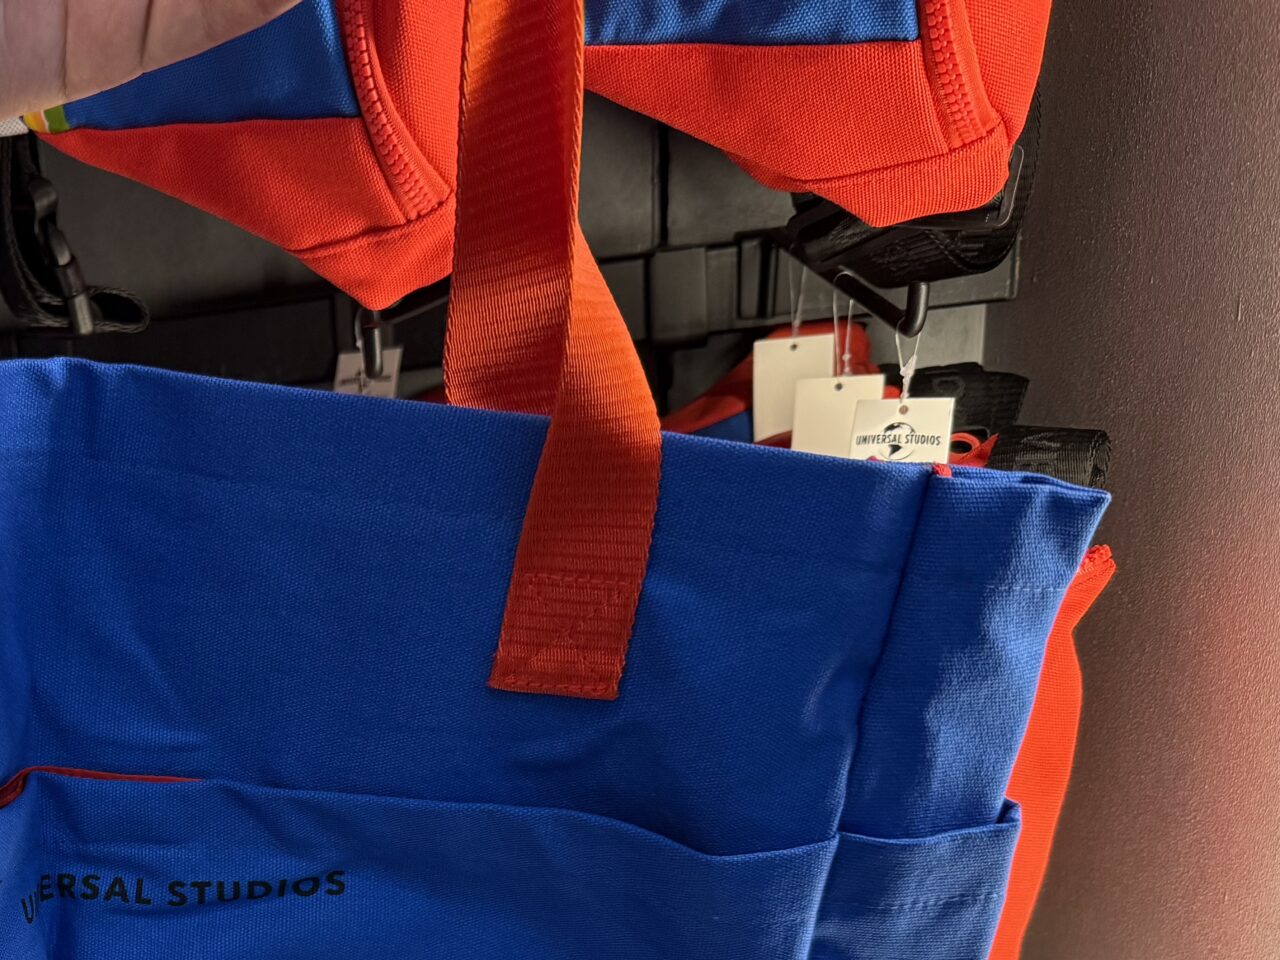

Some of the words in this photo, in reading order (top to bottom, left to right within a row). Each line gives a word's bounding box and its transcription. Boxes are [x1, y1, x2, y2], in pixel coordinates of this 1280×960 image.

[855, 433, 902, 446] UNIVERSAL
[904, 433, 942, 447] STUDIOS
[21, 873, 152, 925] UERSAL
[167, 870, 346, 907] STUDIOS
